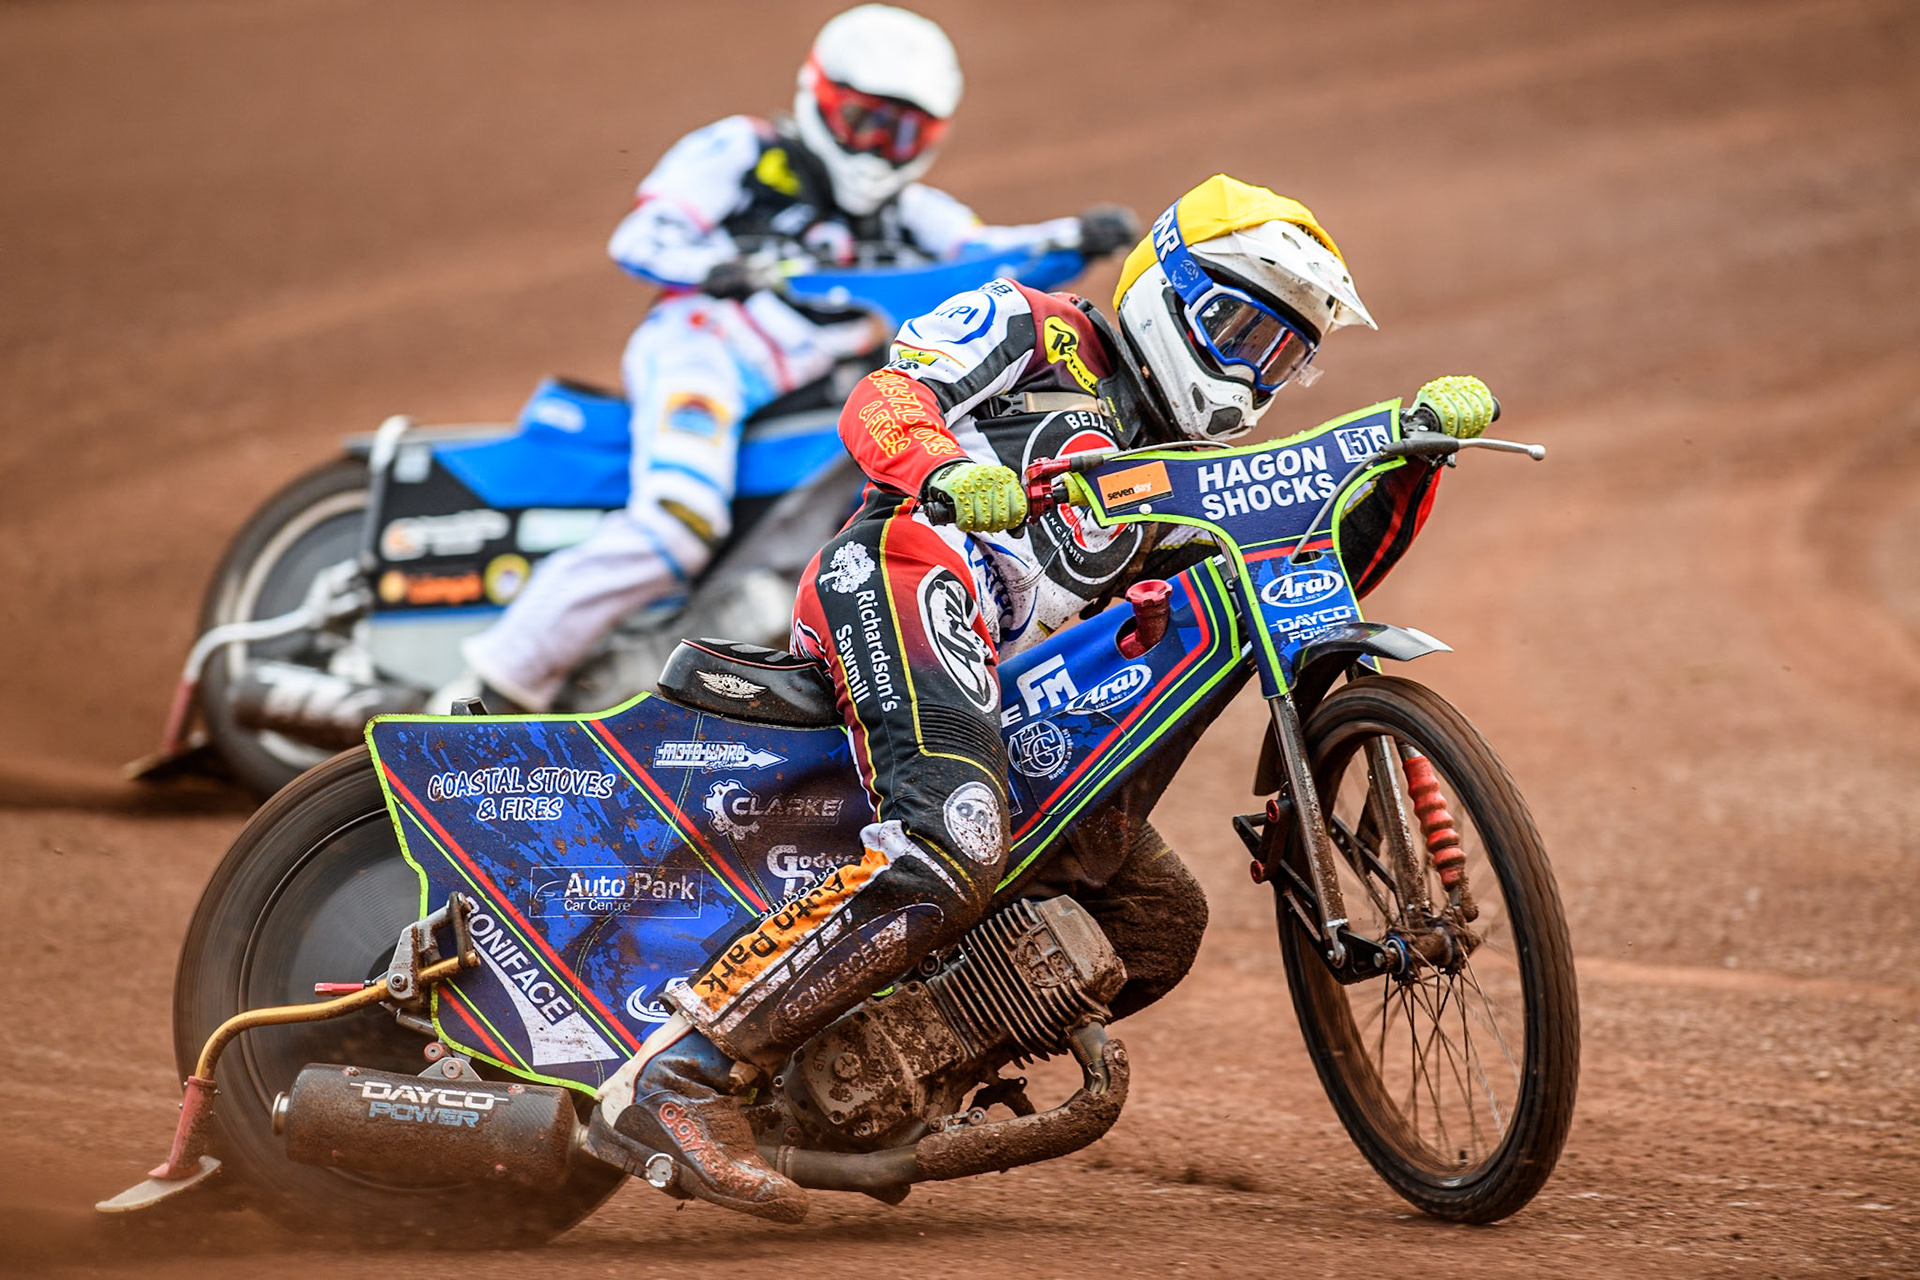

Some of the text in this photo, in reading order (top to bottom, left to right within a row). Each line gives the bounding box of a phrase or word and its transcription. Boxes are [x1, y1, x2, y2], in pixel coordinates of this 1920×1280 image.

[1197, 445, 1328, 494] HAGON
[1107, 482, 1153, 501] sevenday
[1201, 472, 1338, 521] SHOCKS
[1046, 511, 1086, 567] NCHESTER
[1268, 571, 1336, 602] Arai
[1275, 605, 1353, 634] DAYCO
[835, 624, 871, 705] Sawmill
[855, 589, 901, 713] Richardson's
[1016, 653, 1080, 717] FM
[1073, 666, 1142, 709] Arai
[428, 767, 616, 801] COASTAL STOVES
[476, 797, 564, 822] & FIRES
[564, 872, 695, 900] Auto Park
[563, 899, 632, 912] Car Centre
[700, 872, 845, 993] Auto Park
[361, 1081, 496, 1111] DAYCO
[368, 1101, 480, 1128] POWER
